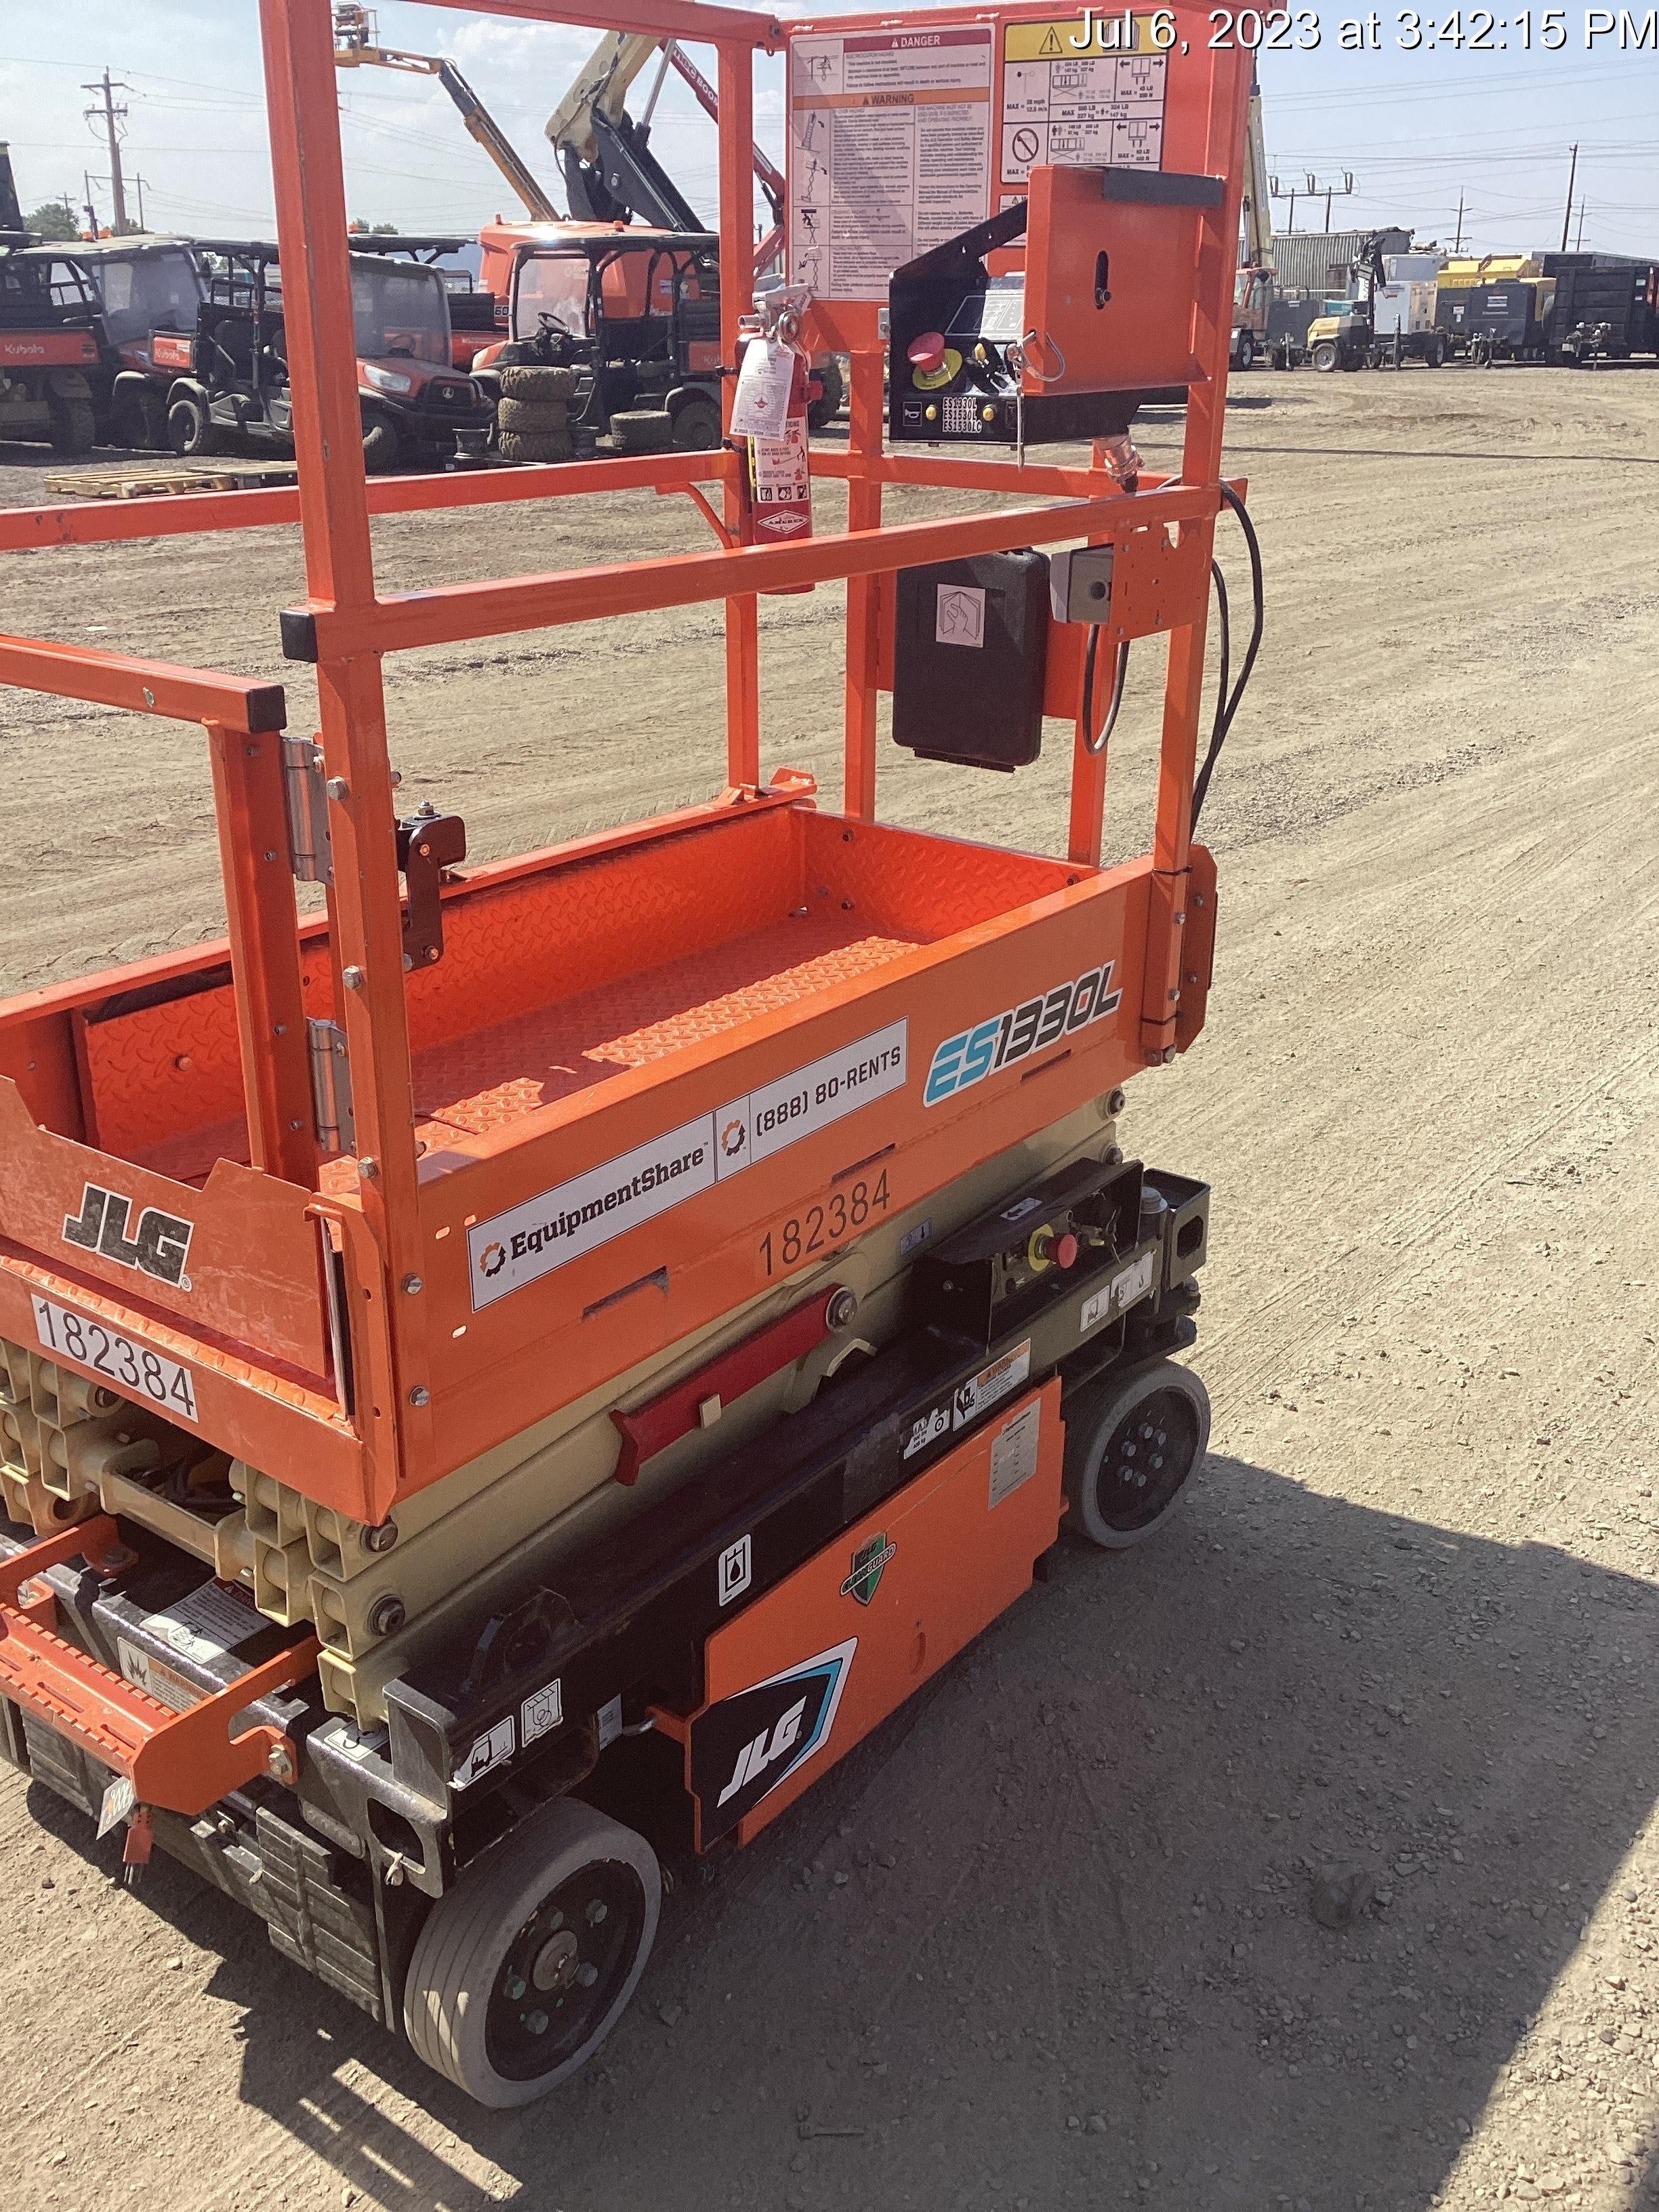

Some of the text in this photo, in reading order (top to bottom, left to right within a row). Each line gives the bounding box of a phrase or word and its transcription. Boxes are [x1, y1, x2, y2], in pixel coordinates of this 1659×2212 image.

[901, 35, 941, 47] DANGER
[872, 94, 914, 104] WARNING
[4, 343, 44, 354] Kubota
[943, 397, 977, 409] ES1330L
[943, 409, 977, 420] ES1530L
[943, 419, 982, 432] ES1530LC
[924, 963, 1122, 1105] ES1330L
[510, 1045, 901, 1261] EquipmentShare (888) 80-RENTS
[62, 1182, 194, 1288] JLG
[759, 1168, 890, 1276] 182384
[38, 1300, 194, 1417] 182384
[716, 1695, 807, 1809] JLG
